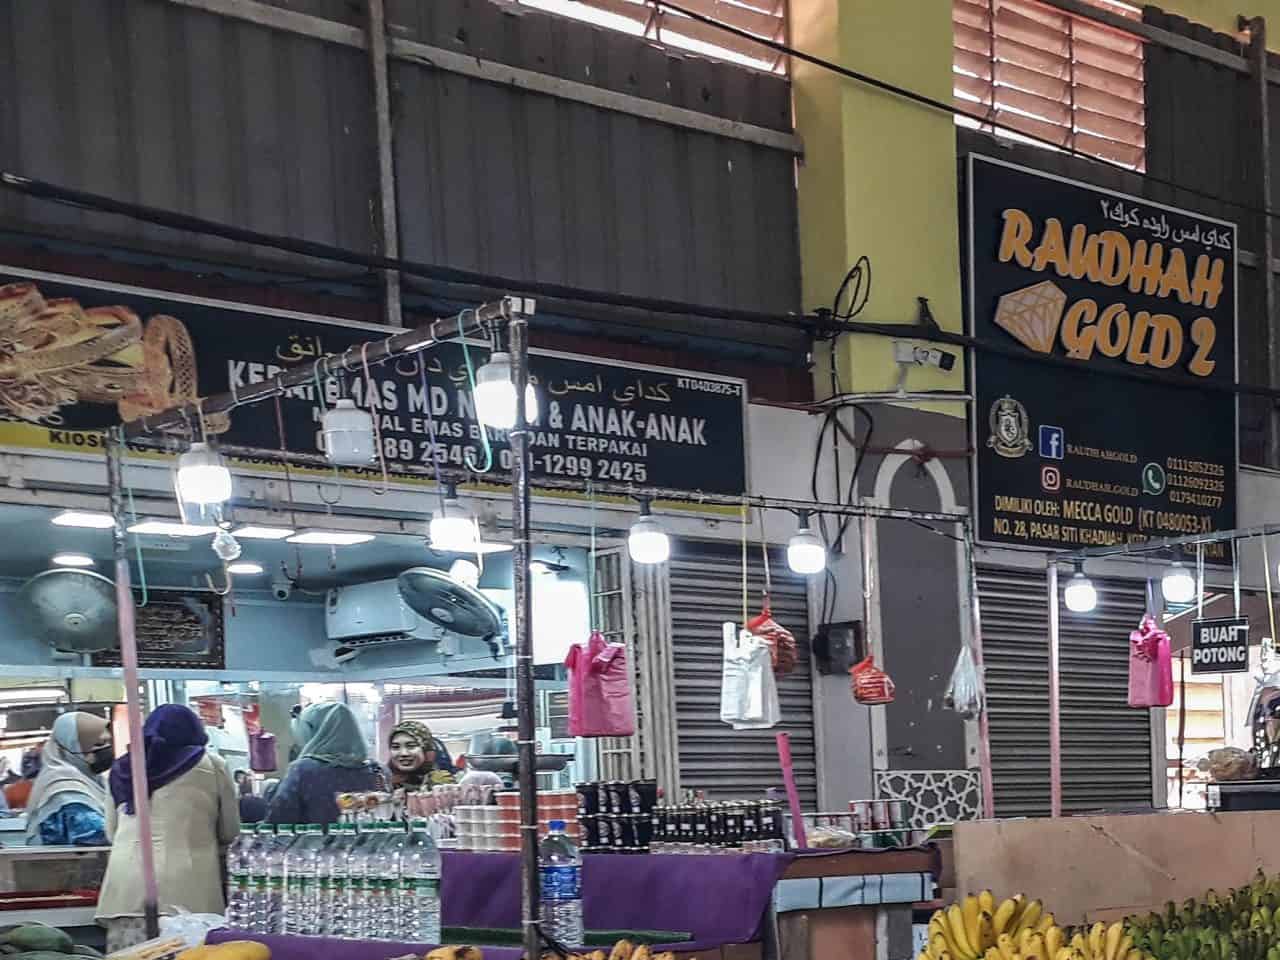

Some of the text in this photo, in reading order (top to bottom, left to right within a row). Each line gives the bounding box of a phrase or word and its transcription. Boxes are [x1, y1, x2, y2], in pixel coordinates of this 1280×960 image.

[999, 208, 1225, 309] RAUDHAH
[1061, 298, 1217, 377] GOLD 2
[406, 383, 449, 417] MD
[549, 399, 564, 429] &
[570, 403, 708, 447] ANAK-ANAK
[411, 417, 464, 439] EMAS
[564, 434, 649, 458] TERPAKAI
[598, 459, 649, 483] 2425
[995, 495, 1033, 515] DIMILIKI
[1034, 499, 1061, 517] OLEH:
[1062, 499, 1103, 522] MECCA
[1103, 504, 1134, 526] GOLD
[992, 517, 1010, 536] NO.
[1029, 521, 1060, 541] PASAR
[1060, 525, 1079, 544] SITI
[1200, 625, 1239, 644] BUAH
[1192, 645, 1247, 665] POTONG
